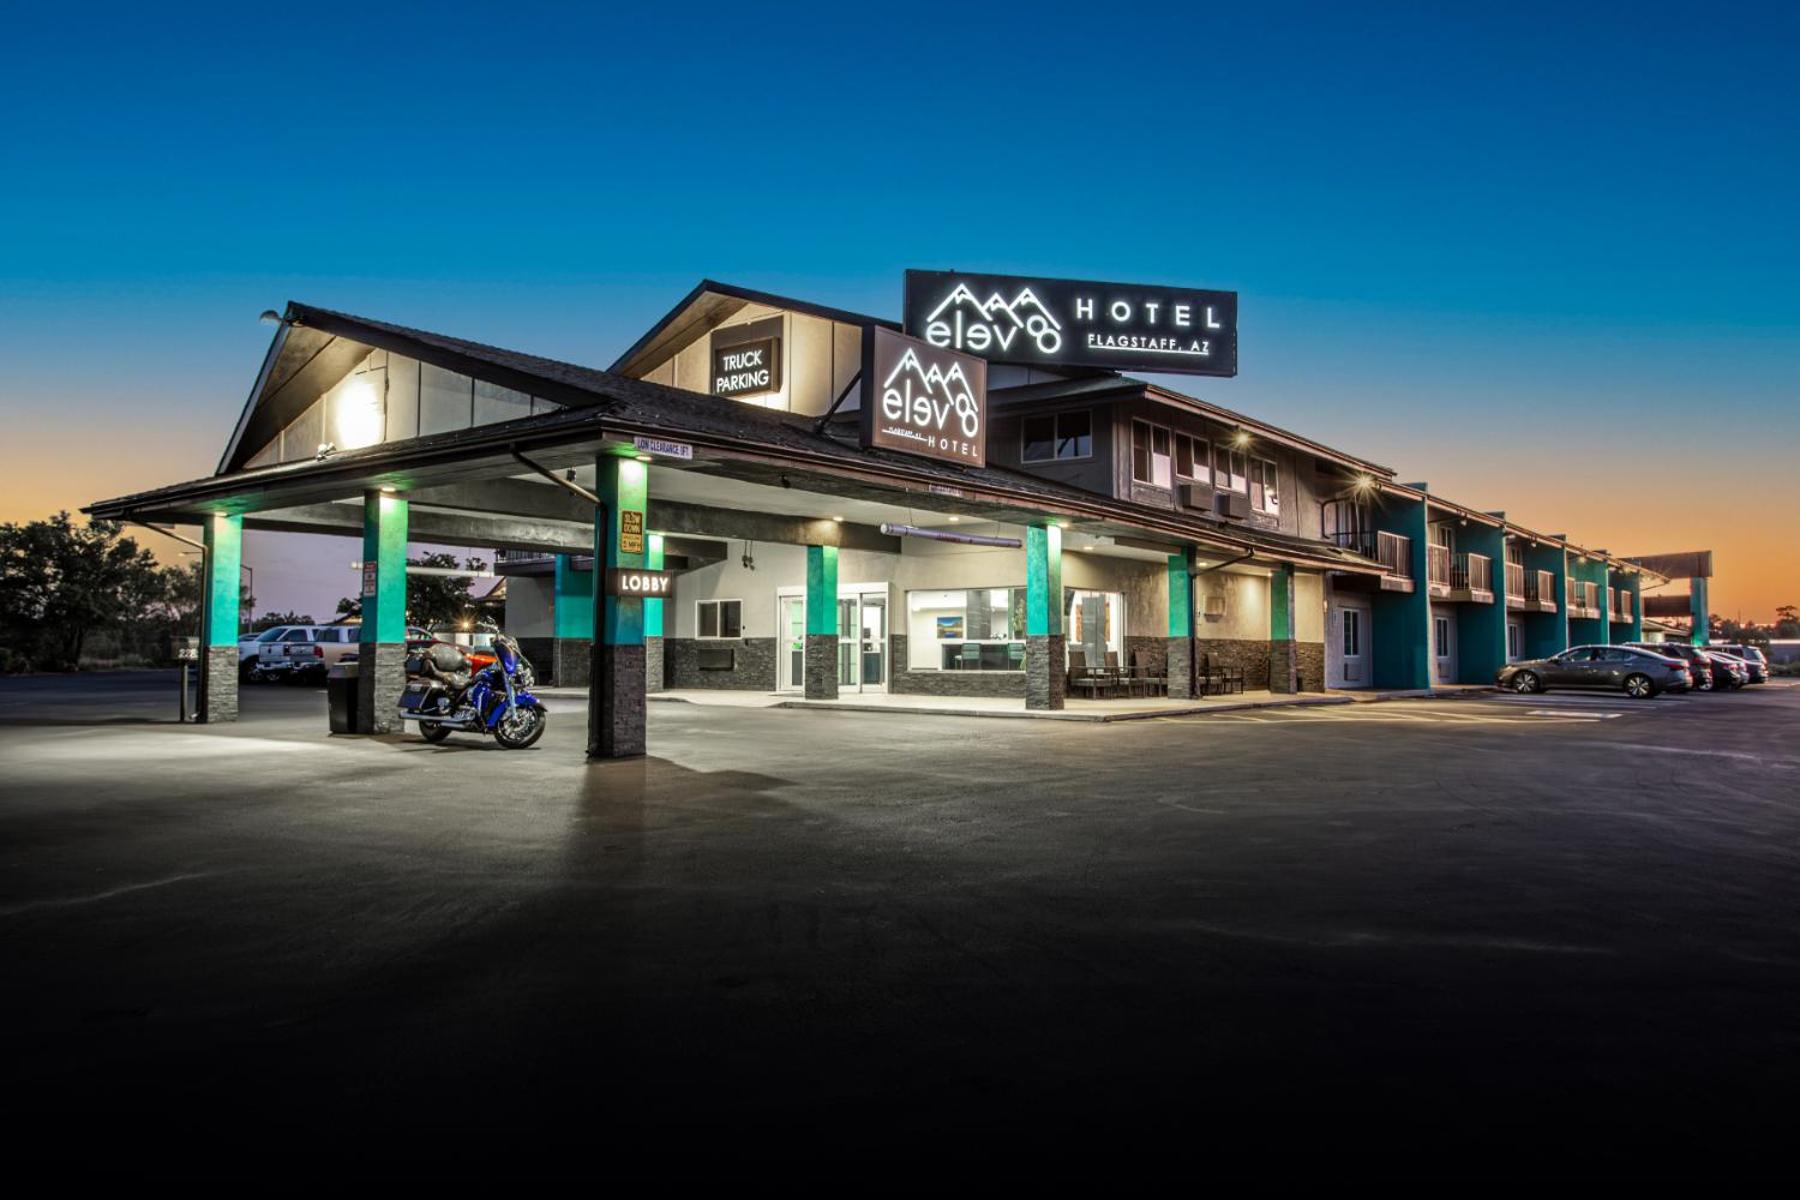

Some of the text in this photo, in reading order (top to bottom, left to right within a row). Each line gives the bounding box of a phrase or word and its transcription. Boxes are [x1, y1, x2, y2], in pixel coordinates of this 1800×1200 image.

[1076, 298, 1220, 328] HOTEL
[1190, 340, 1209, 353] AZ
[723, 350, 763, 372] TRUCK
[716, 369, 769, 394] PARKING
[928, 435, 978, 457] HOTEL
[621, 575, 669, 593] LOBBY
